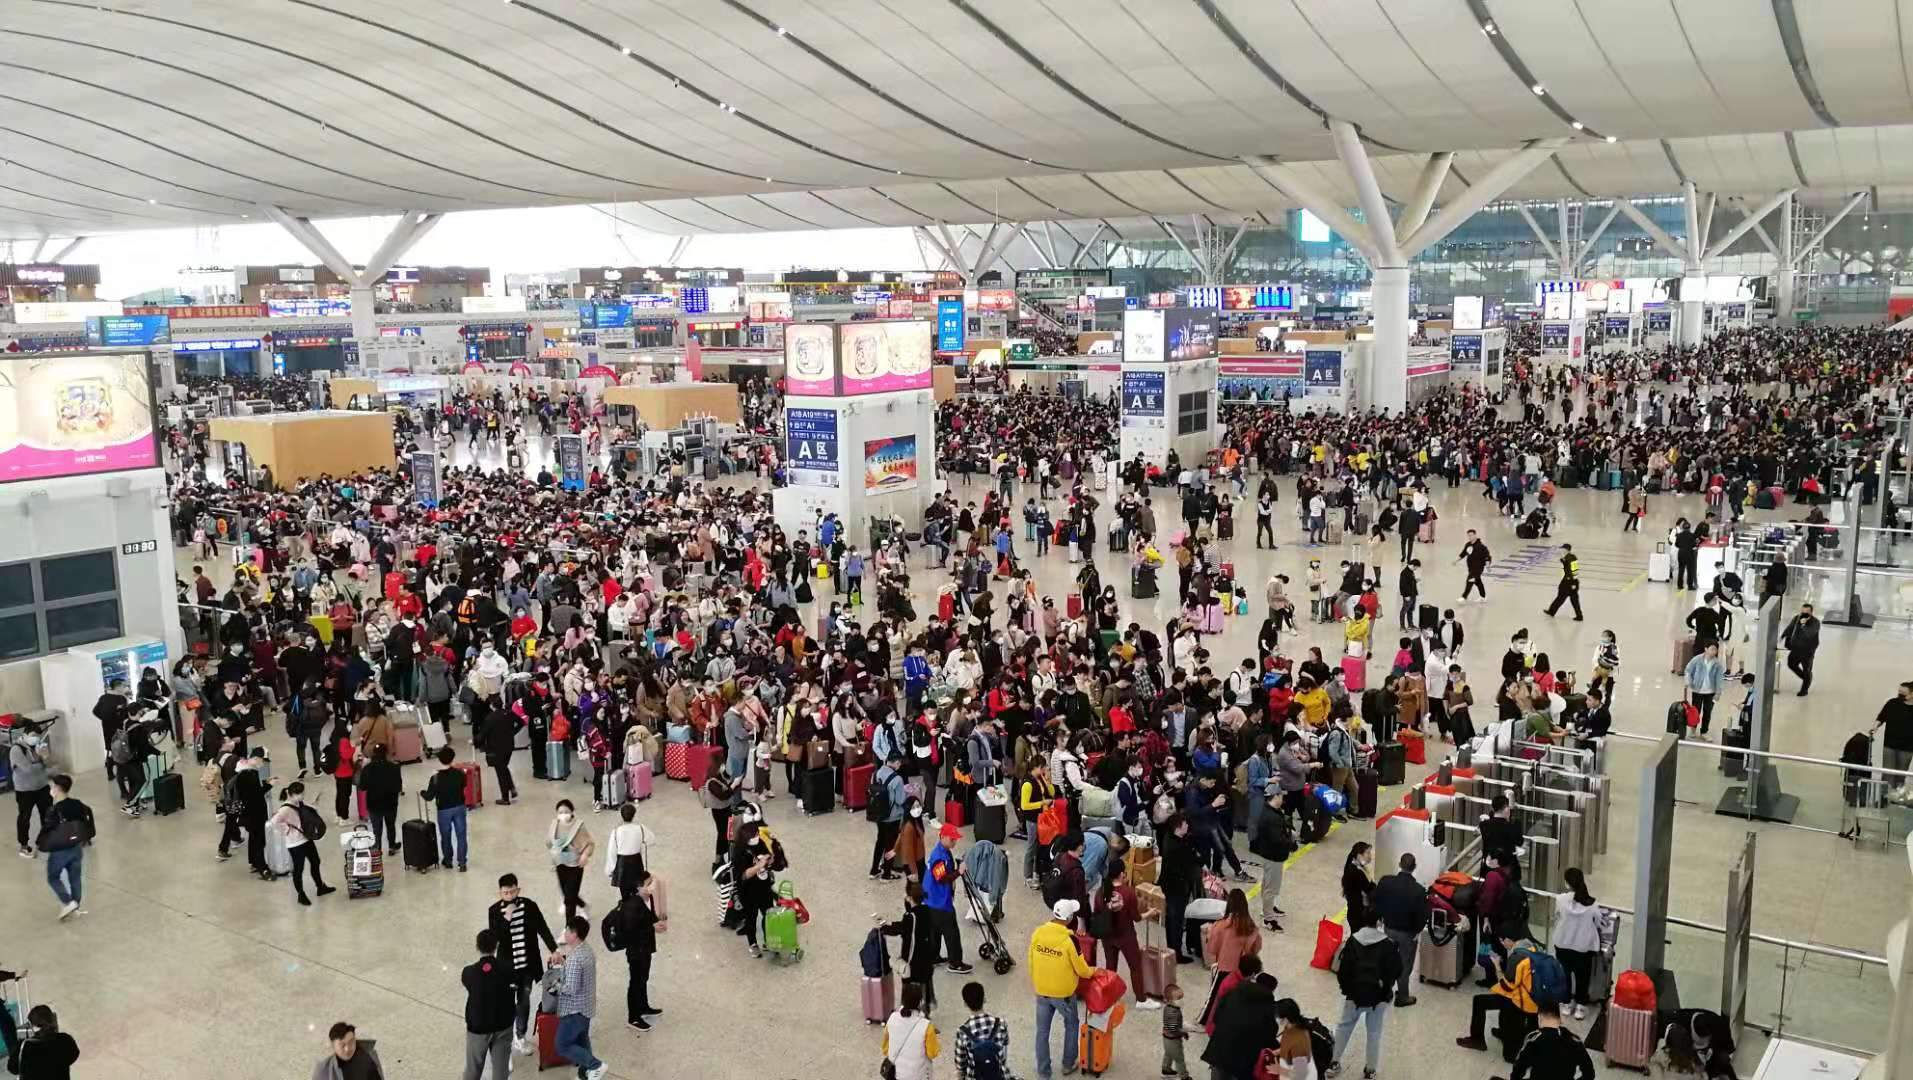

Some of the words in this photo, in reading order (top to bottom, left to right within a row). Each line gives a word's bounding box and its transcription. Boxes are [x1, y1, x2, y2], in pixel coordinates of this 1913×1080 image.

[1547, 337, 1556, 345] A
[1458, 350, 1466, 358] A
[1312, 369, 1322, 380] A
[1131, 394, 1143, 408] A
[1147, 395, 1155, 404] 区
[799, 440, 812, 459] A
[817, 441, 827, 455] 区
